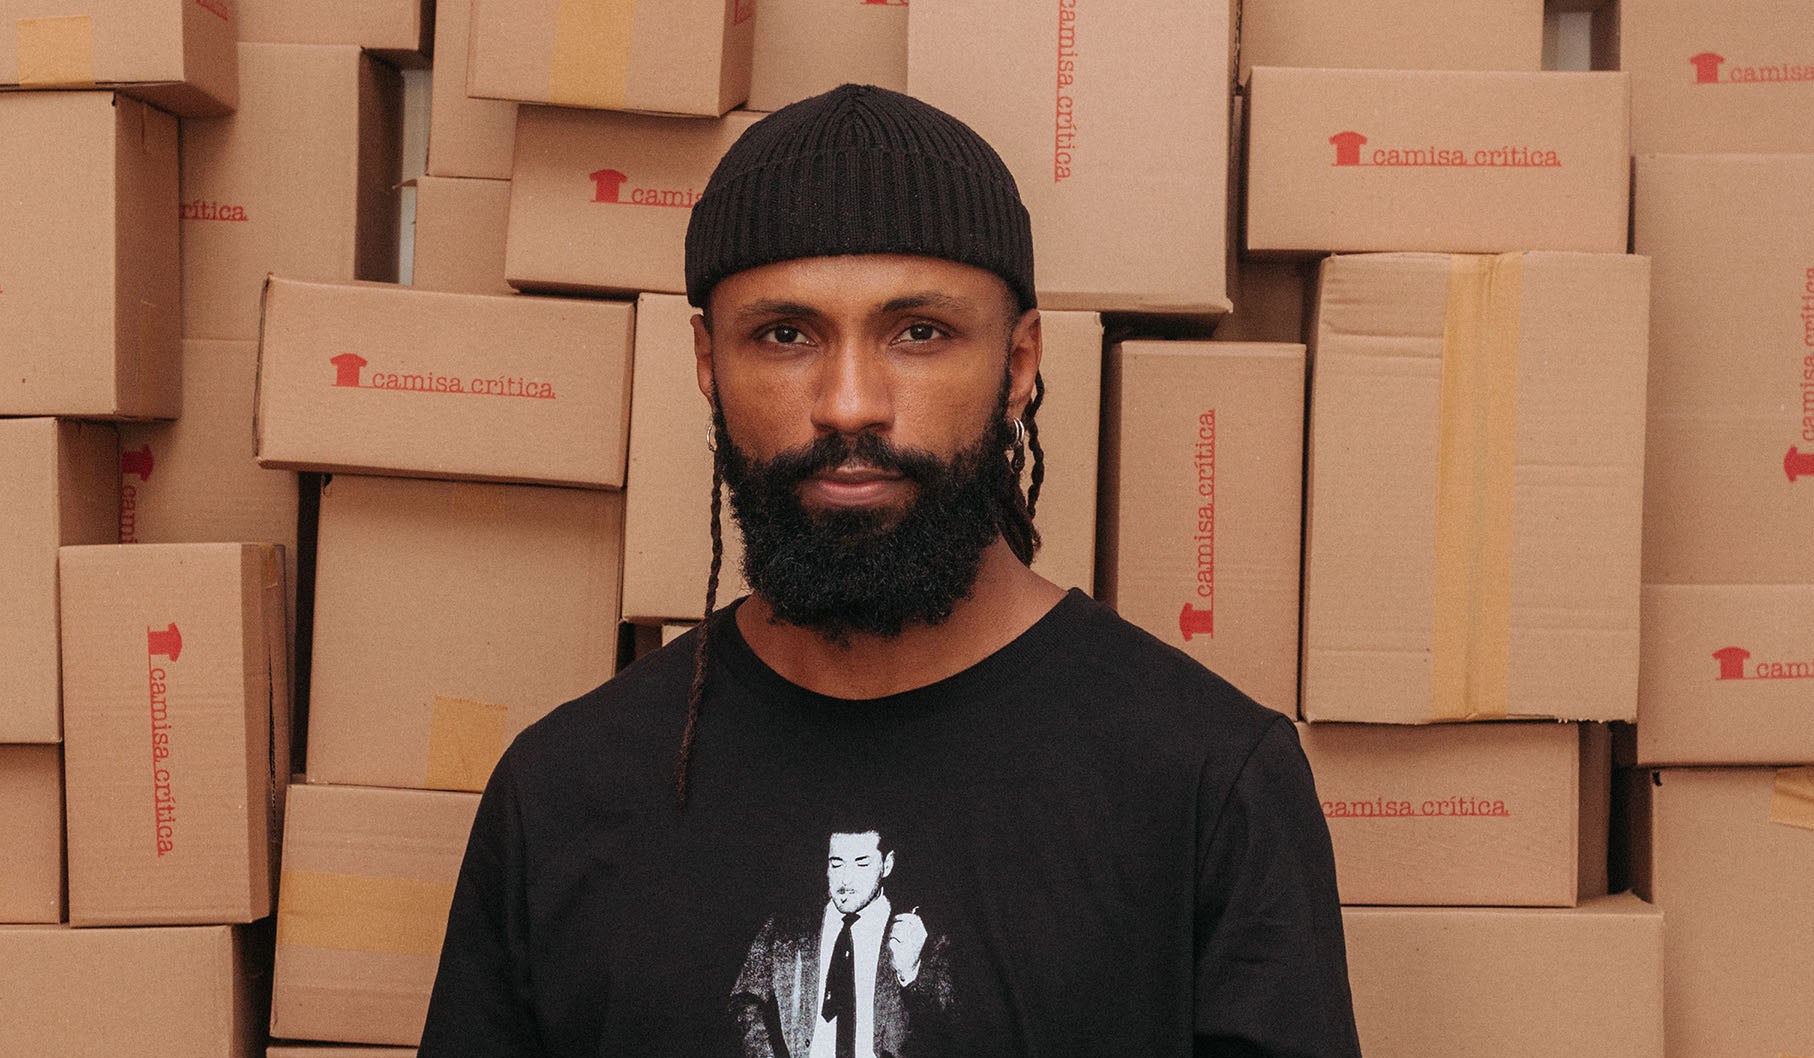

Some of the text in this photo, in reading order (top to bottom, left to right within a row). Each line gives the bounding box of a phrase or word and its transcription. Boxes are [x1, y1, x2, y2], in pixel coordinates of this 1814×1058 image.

[1054, 0, 1078, 184] camisa crítica
[1372, 145, 1562, 168] camisa crítica
[180, 199, 248, 221] rítica
[631, 188, 704, 208] cami
[372, 371, 556, 400] camisa crítica
[120, 485, 139, 544] cami
[1194, 408, 1216, 598] camisa crítica
[150, 667, 177, 858] camisa crítica
[1321, 796, 1510, 818] camisa crítica
